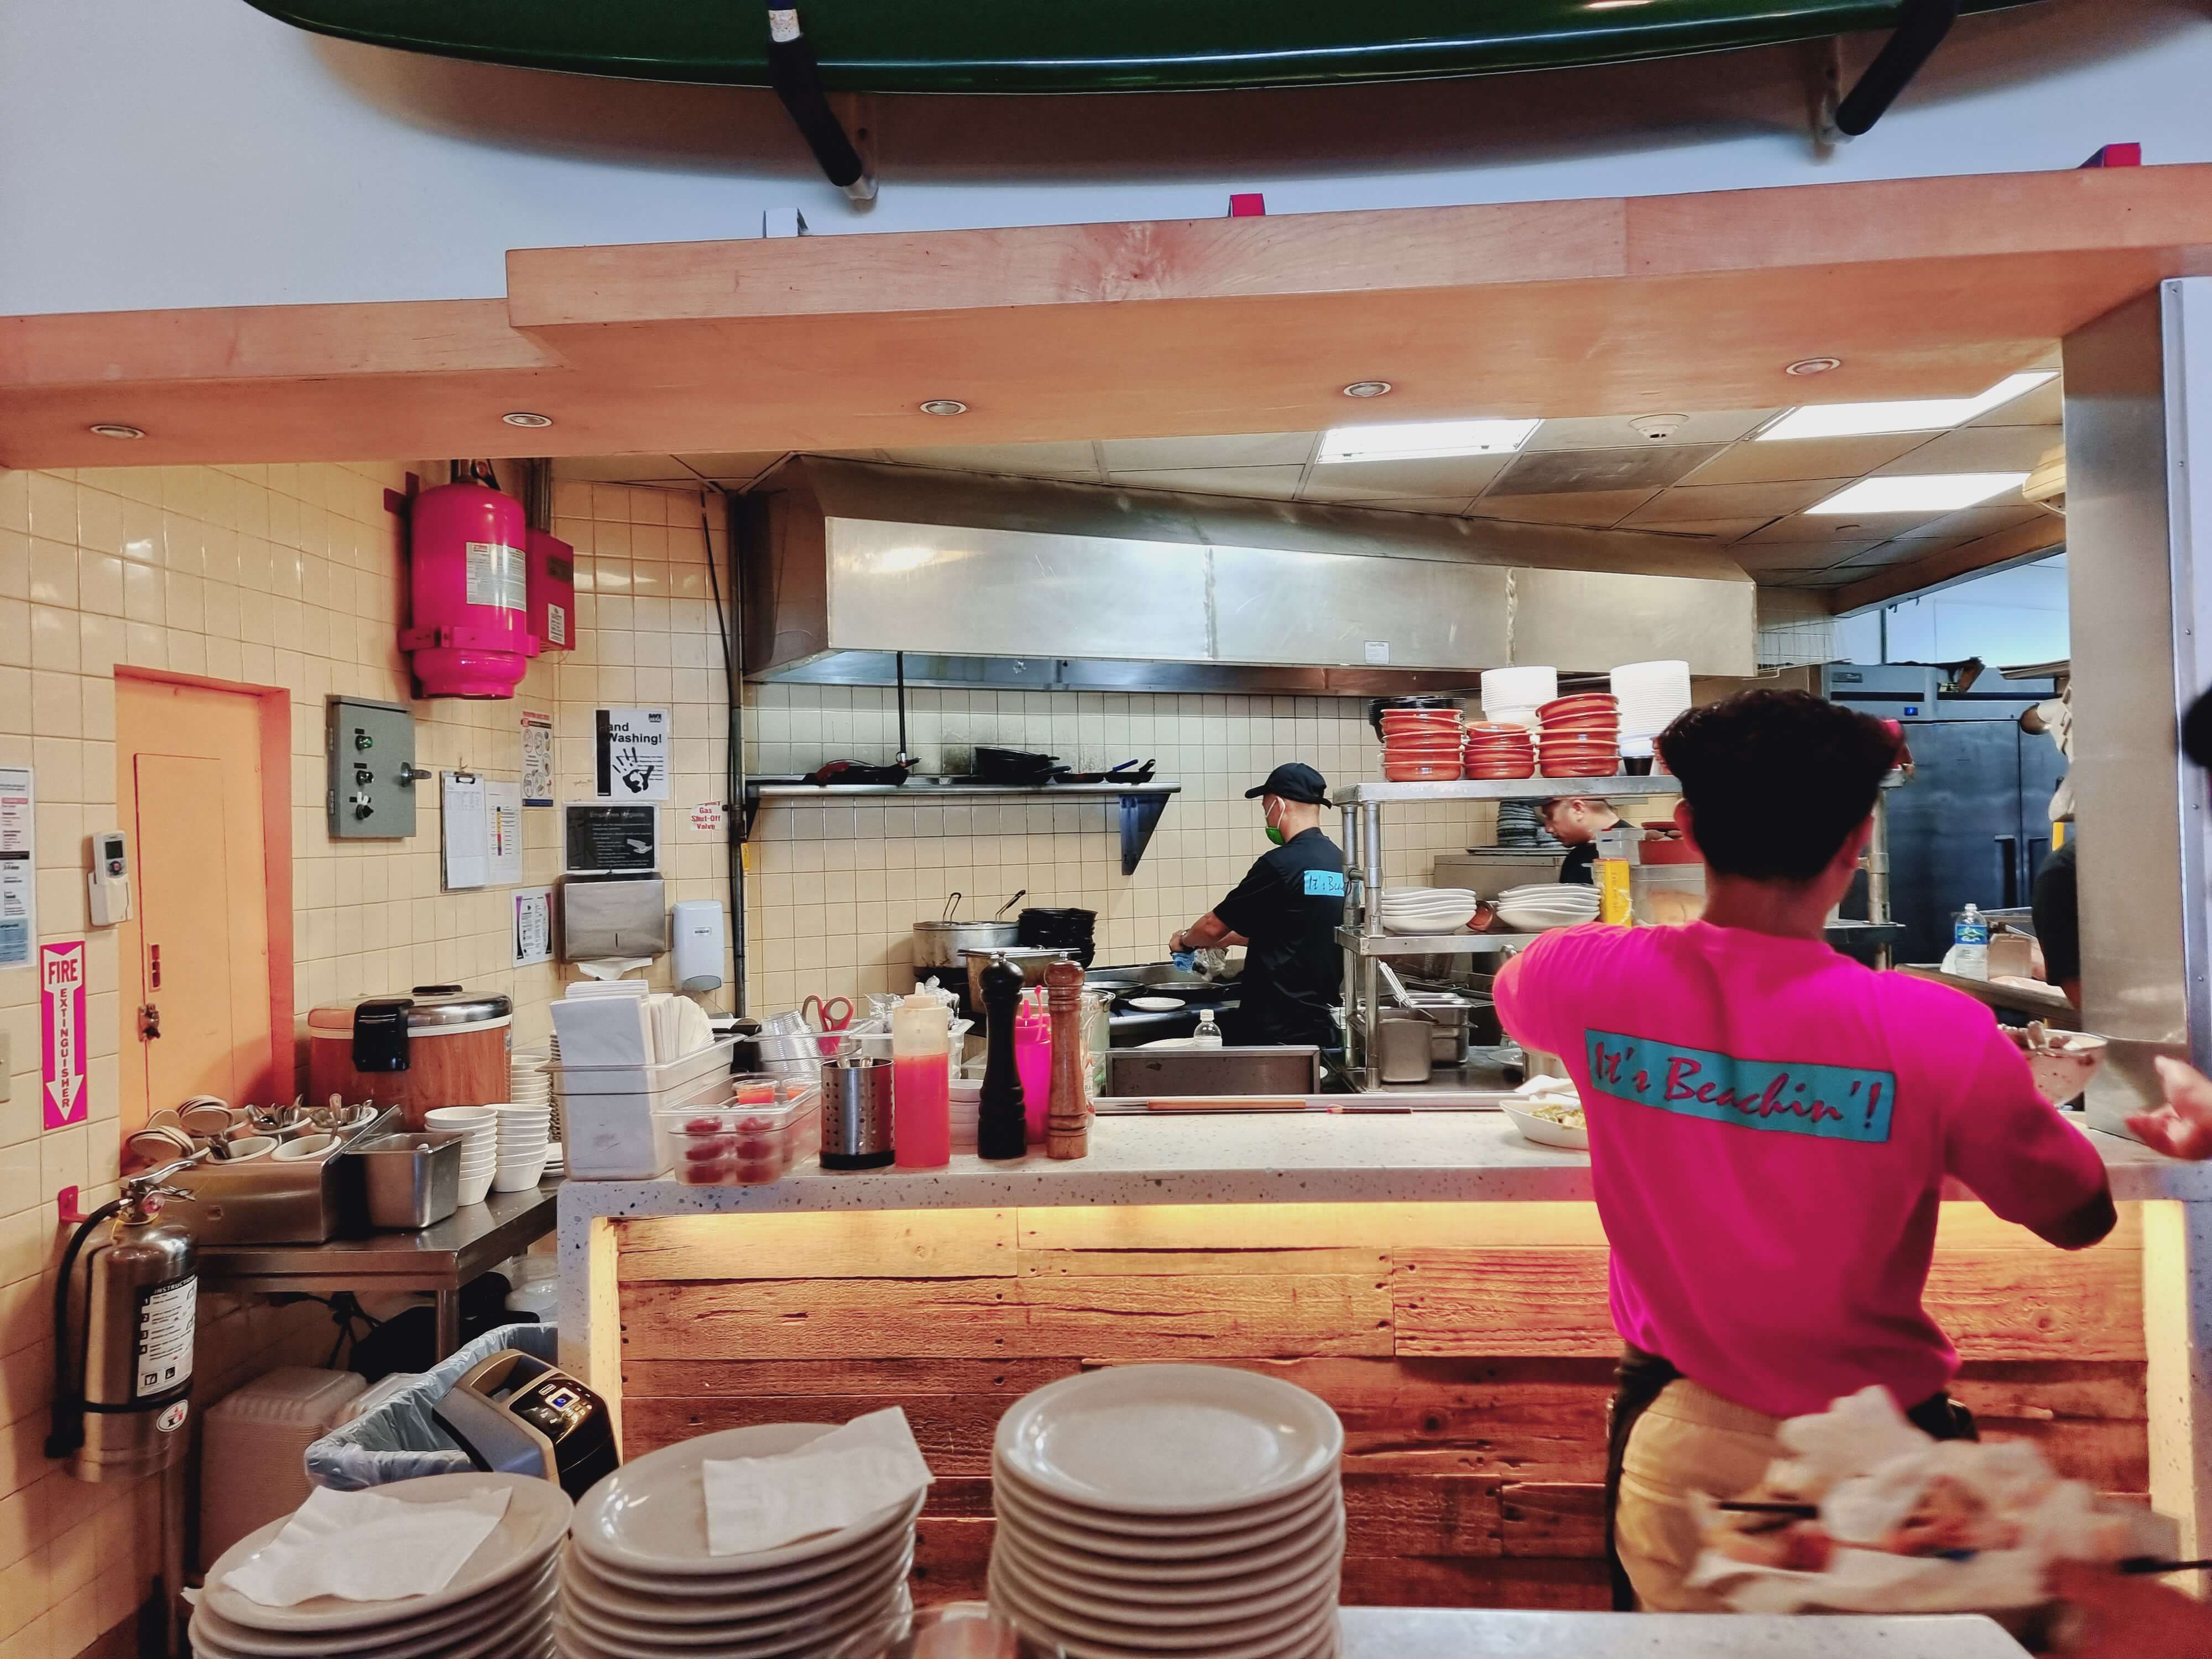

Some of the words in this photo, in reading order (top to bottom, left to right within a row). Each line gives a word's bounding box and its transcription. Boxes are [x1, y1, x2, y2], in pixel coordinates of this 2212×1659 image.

[609, 722, 629, 732] and
[609, 733, 662, 745] Washing!
[48, 959, 78, 985] FIRE
[60, 988, 70, 1108] EXTINGUISHER
[1595, 1041, 1652, 1093] It's
[1664, 1056, 1882, 1129] Beachin'!
